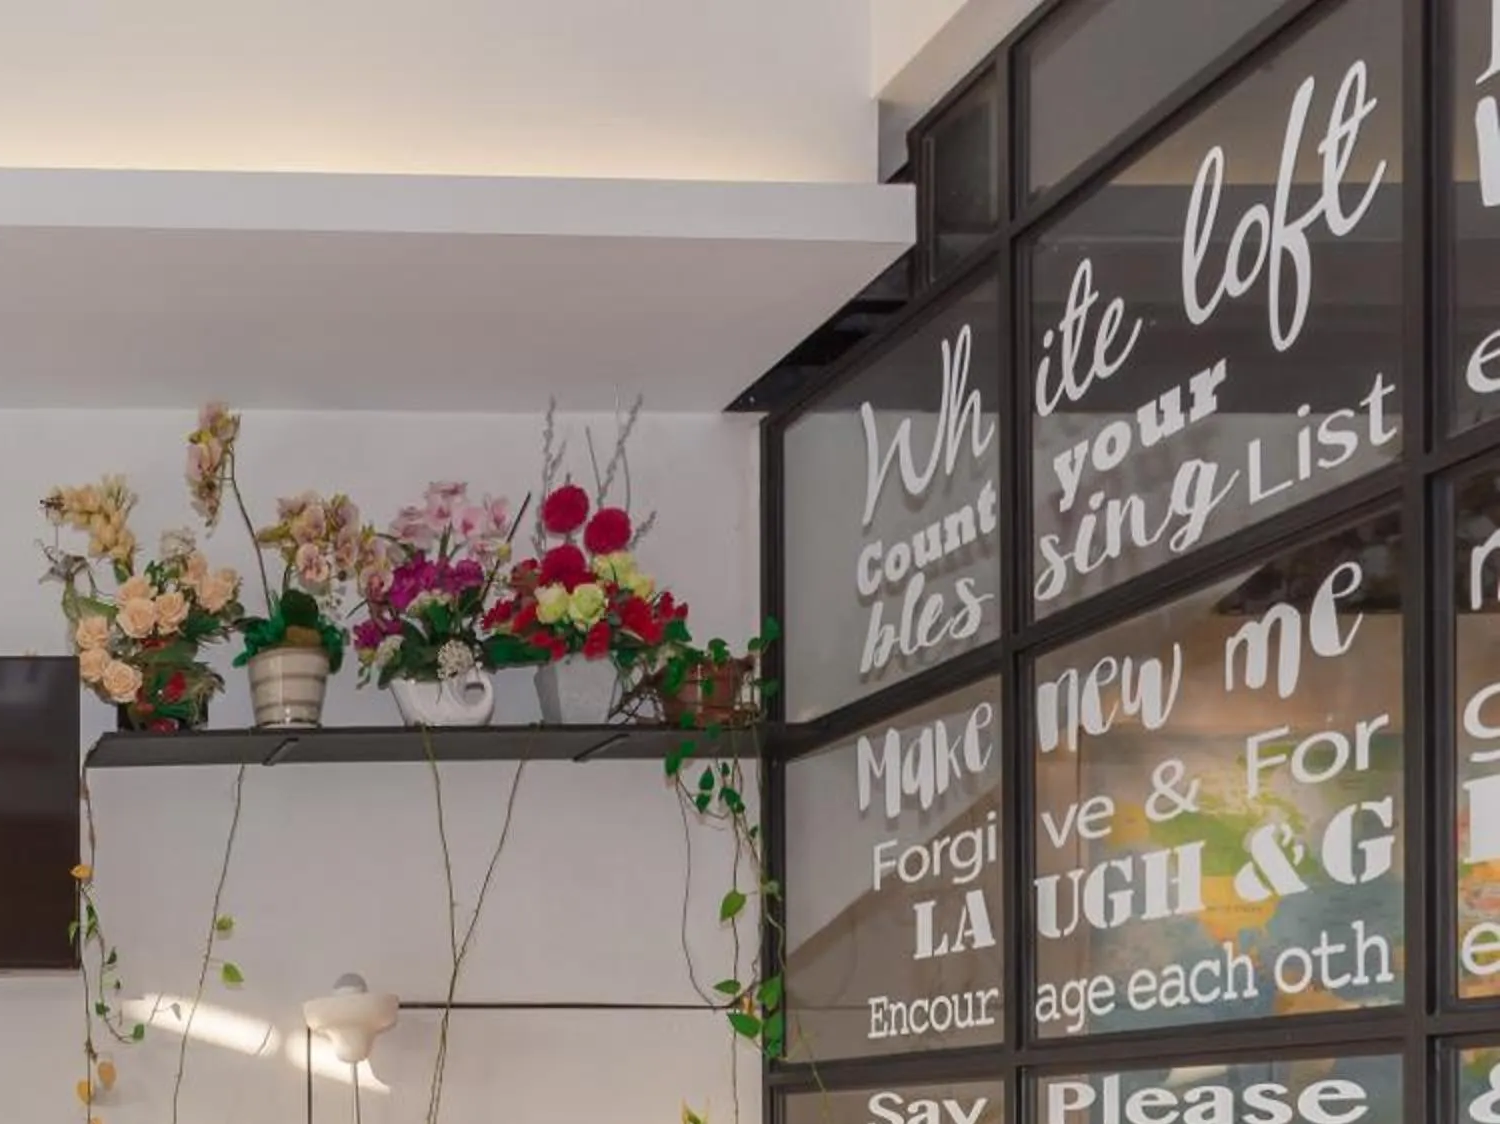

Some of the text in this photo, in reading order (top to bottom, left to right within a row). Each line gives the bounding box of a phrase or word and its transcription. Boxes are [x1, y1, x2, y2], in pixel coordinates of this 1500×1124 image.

[1182, 59, 1386, 351] loft
[856, 358, 1227, 595] Count your
[856, 702, 993, 819] Make
[1036, 641, 1182, 752] new
[1144, 759, 1199, 823] &
[1233, 821, 1308, 904] &
[1126, 942, 1256, 1013] each
